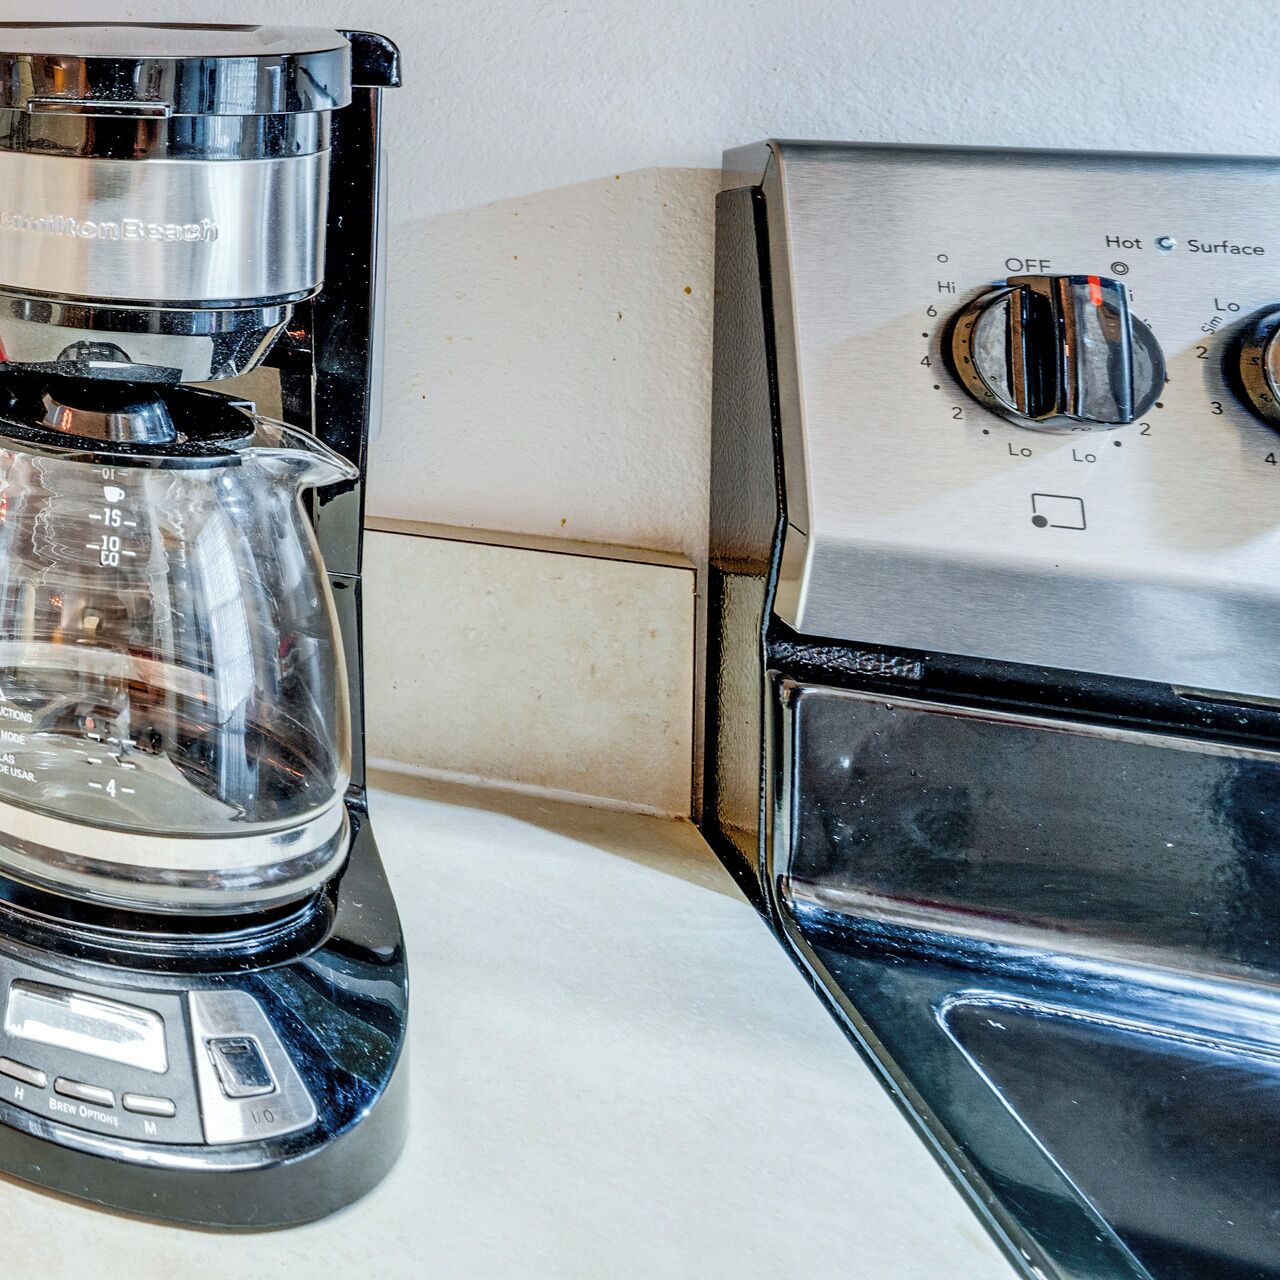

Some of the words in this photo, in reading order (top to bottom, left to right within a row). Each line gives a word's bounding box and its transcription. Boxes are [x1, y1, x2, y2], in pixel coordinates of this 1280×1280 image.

[121, 218, 220, 242] Beach
[1105, 235, 1142, 249] Hot
[1188, 239, 1265, 256] Surface
[1005, 258, 1051, 273] OFF
[938, 281, 956, 293] Hi
[1214, 298, 1240, 311] Lo
[926, 306, 937, 318] 6
[1201, 316, 1223, 335] Sim
[1196, 346, 1209, 359] 2
[920, 356, 932, 367] 4
[952, 407, 963, 419] 2
[1211, 402, 1223, 415] 3
[1140, 422, 1151, 436] 2
[1008, 442, 1032, 457] Lo
[1073, 449, 1097, 463] Lo
[1265, 452, 1277, 466] 4
[1, 730, 25, 745] MODE
[106, 779, 116, 797] 4
[14, 1087, 25, 1100] H
[48, 1098, 77, 1117] BREW
[79, 1105, 119, 1127] OPTIONS
[144, 1121, 158, 1135] M
